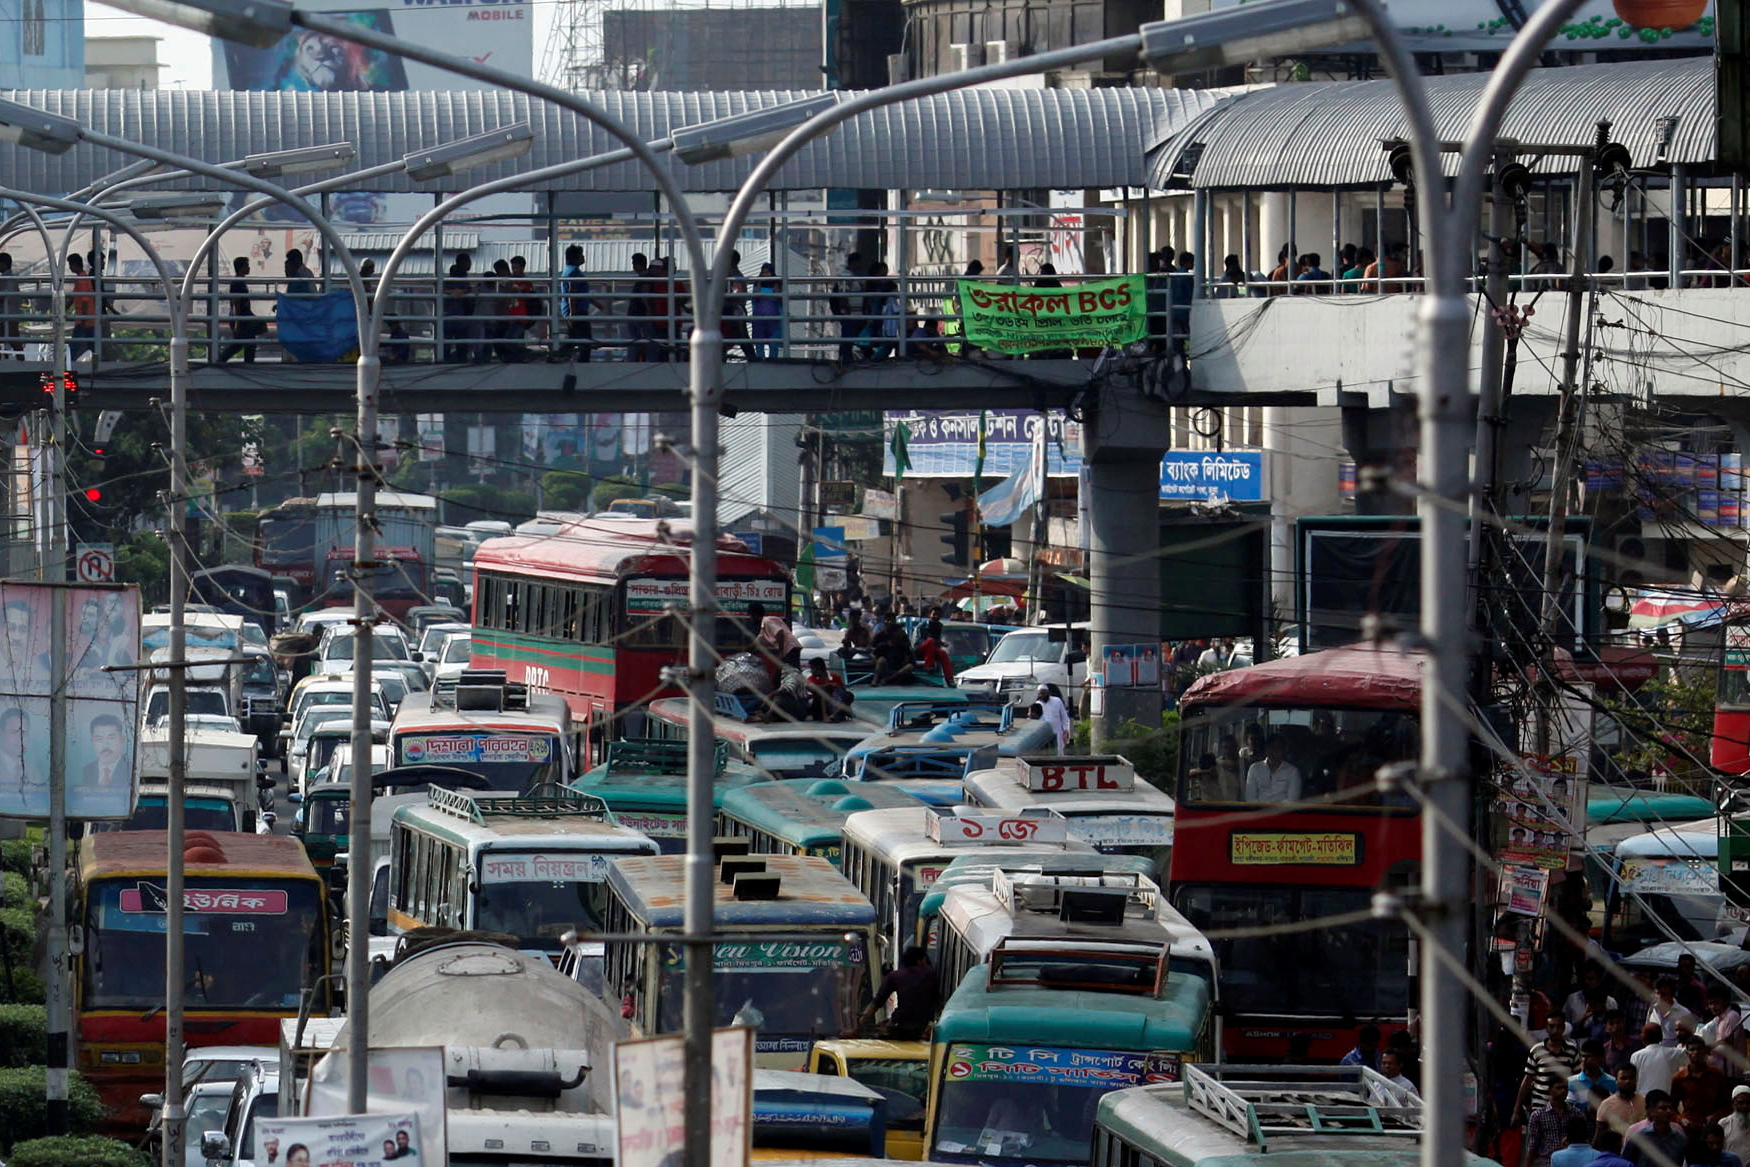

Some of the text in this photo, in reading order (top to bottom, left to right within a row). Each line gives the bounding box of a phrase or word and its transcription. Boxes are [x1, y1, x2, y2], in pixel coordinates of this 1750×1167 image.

[467, 9, 524, 21] MOBILE
[1078, 283, 1132, 313] BCS
[1202, 456, 1251, 481] লিমিটেড
[1041, 765, 1119, 790] BTL
[487, 861, 526, 878] সময়
[760, 941, 843, 959] Vision
[954, 1044, 976, 1060] ই
[987, 1046, 1017, 1060] টি
[1027, 1048, 1061, 1063] সি
